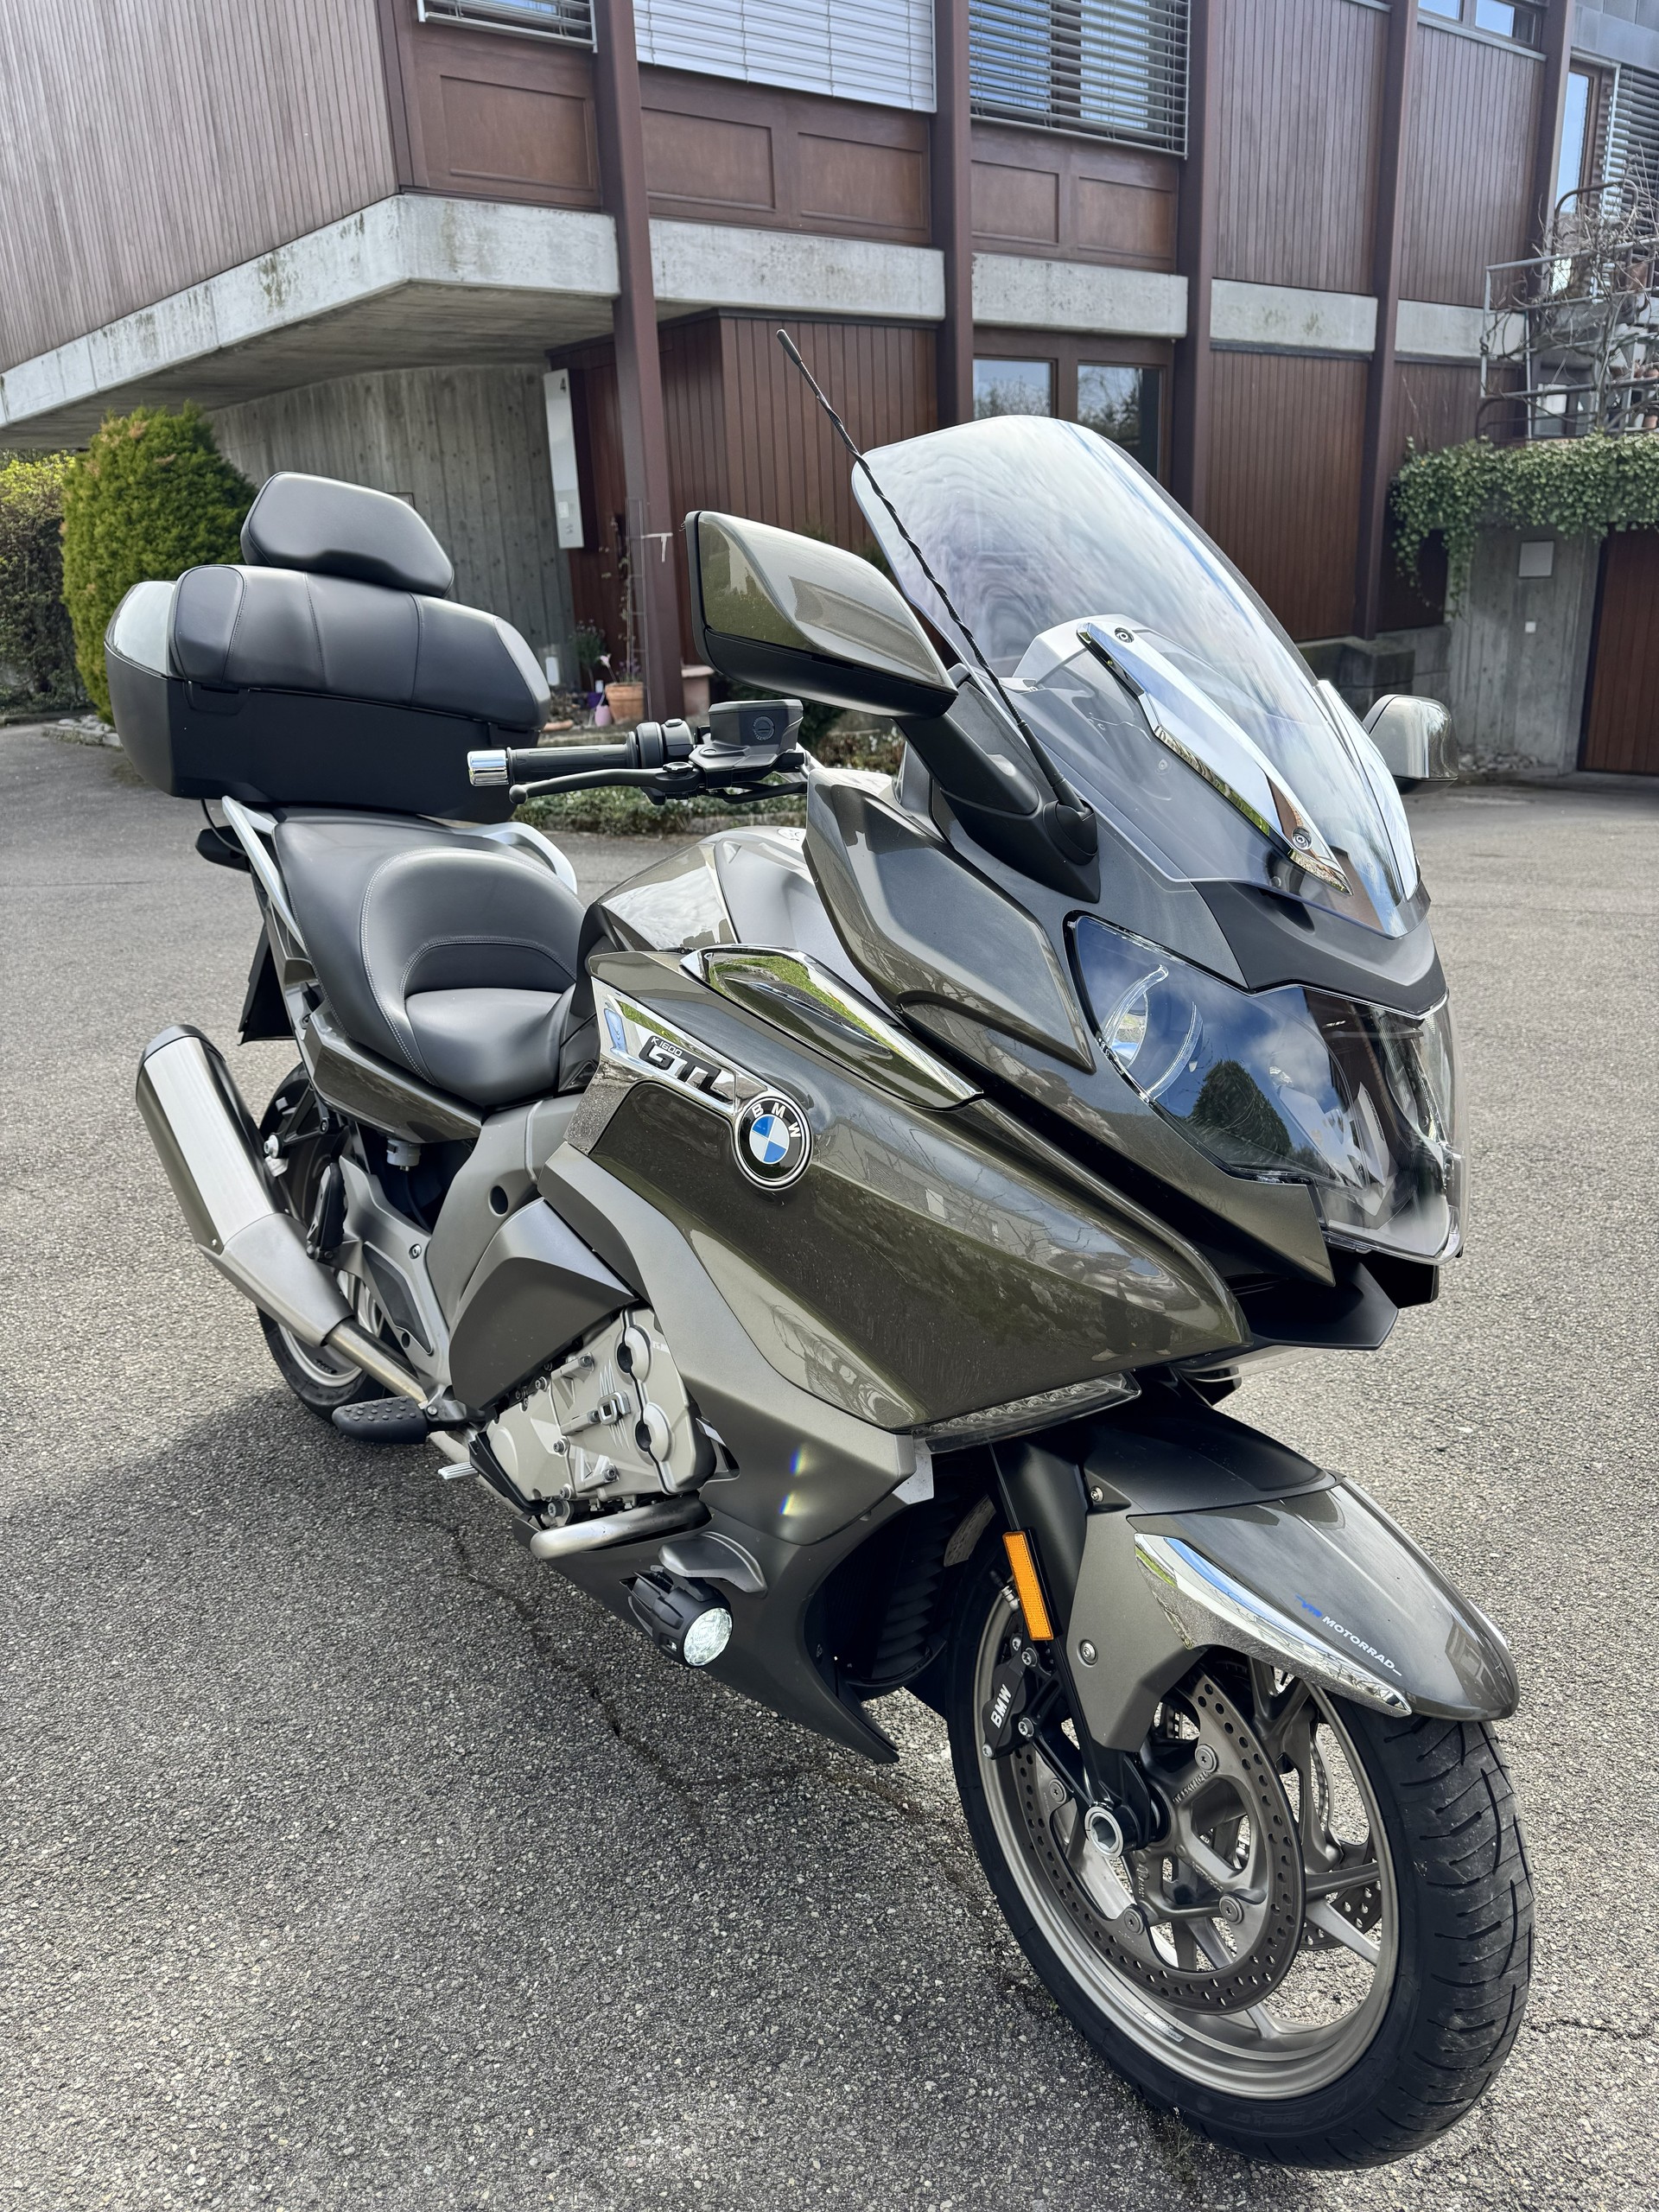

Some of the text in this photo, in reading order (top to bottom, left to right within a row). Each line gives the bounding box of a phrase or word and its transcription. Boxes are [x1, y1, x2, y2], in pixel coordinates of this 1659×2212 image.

[559, 377, 567, 393] 4
[651, 1037, 683, 1057] K 1600
[639, 1035, 734, 1103] GTL
[751, 1102, 802, 1138] BMW
[990, 1684, 1012, 1728] BMW
